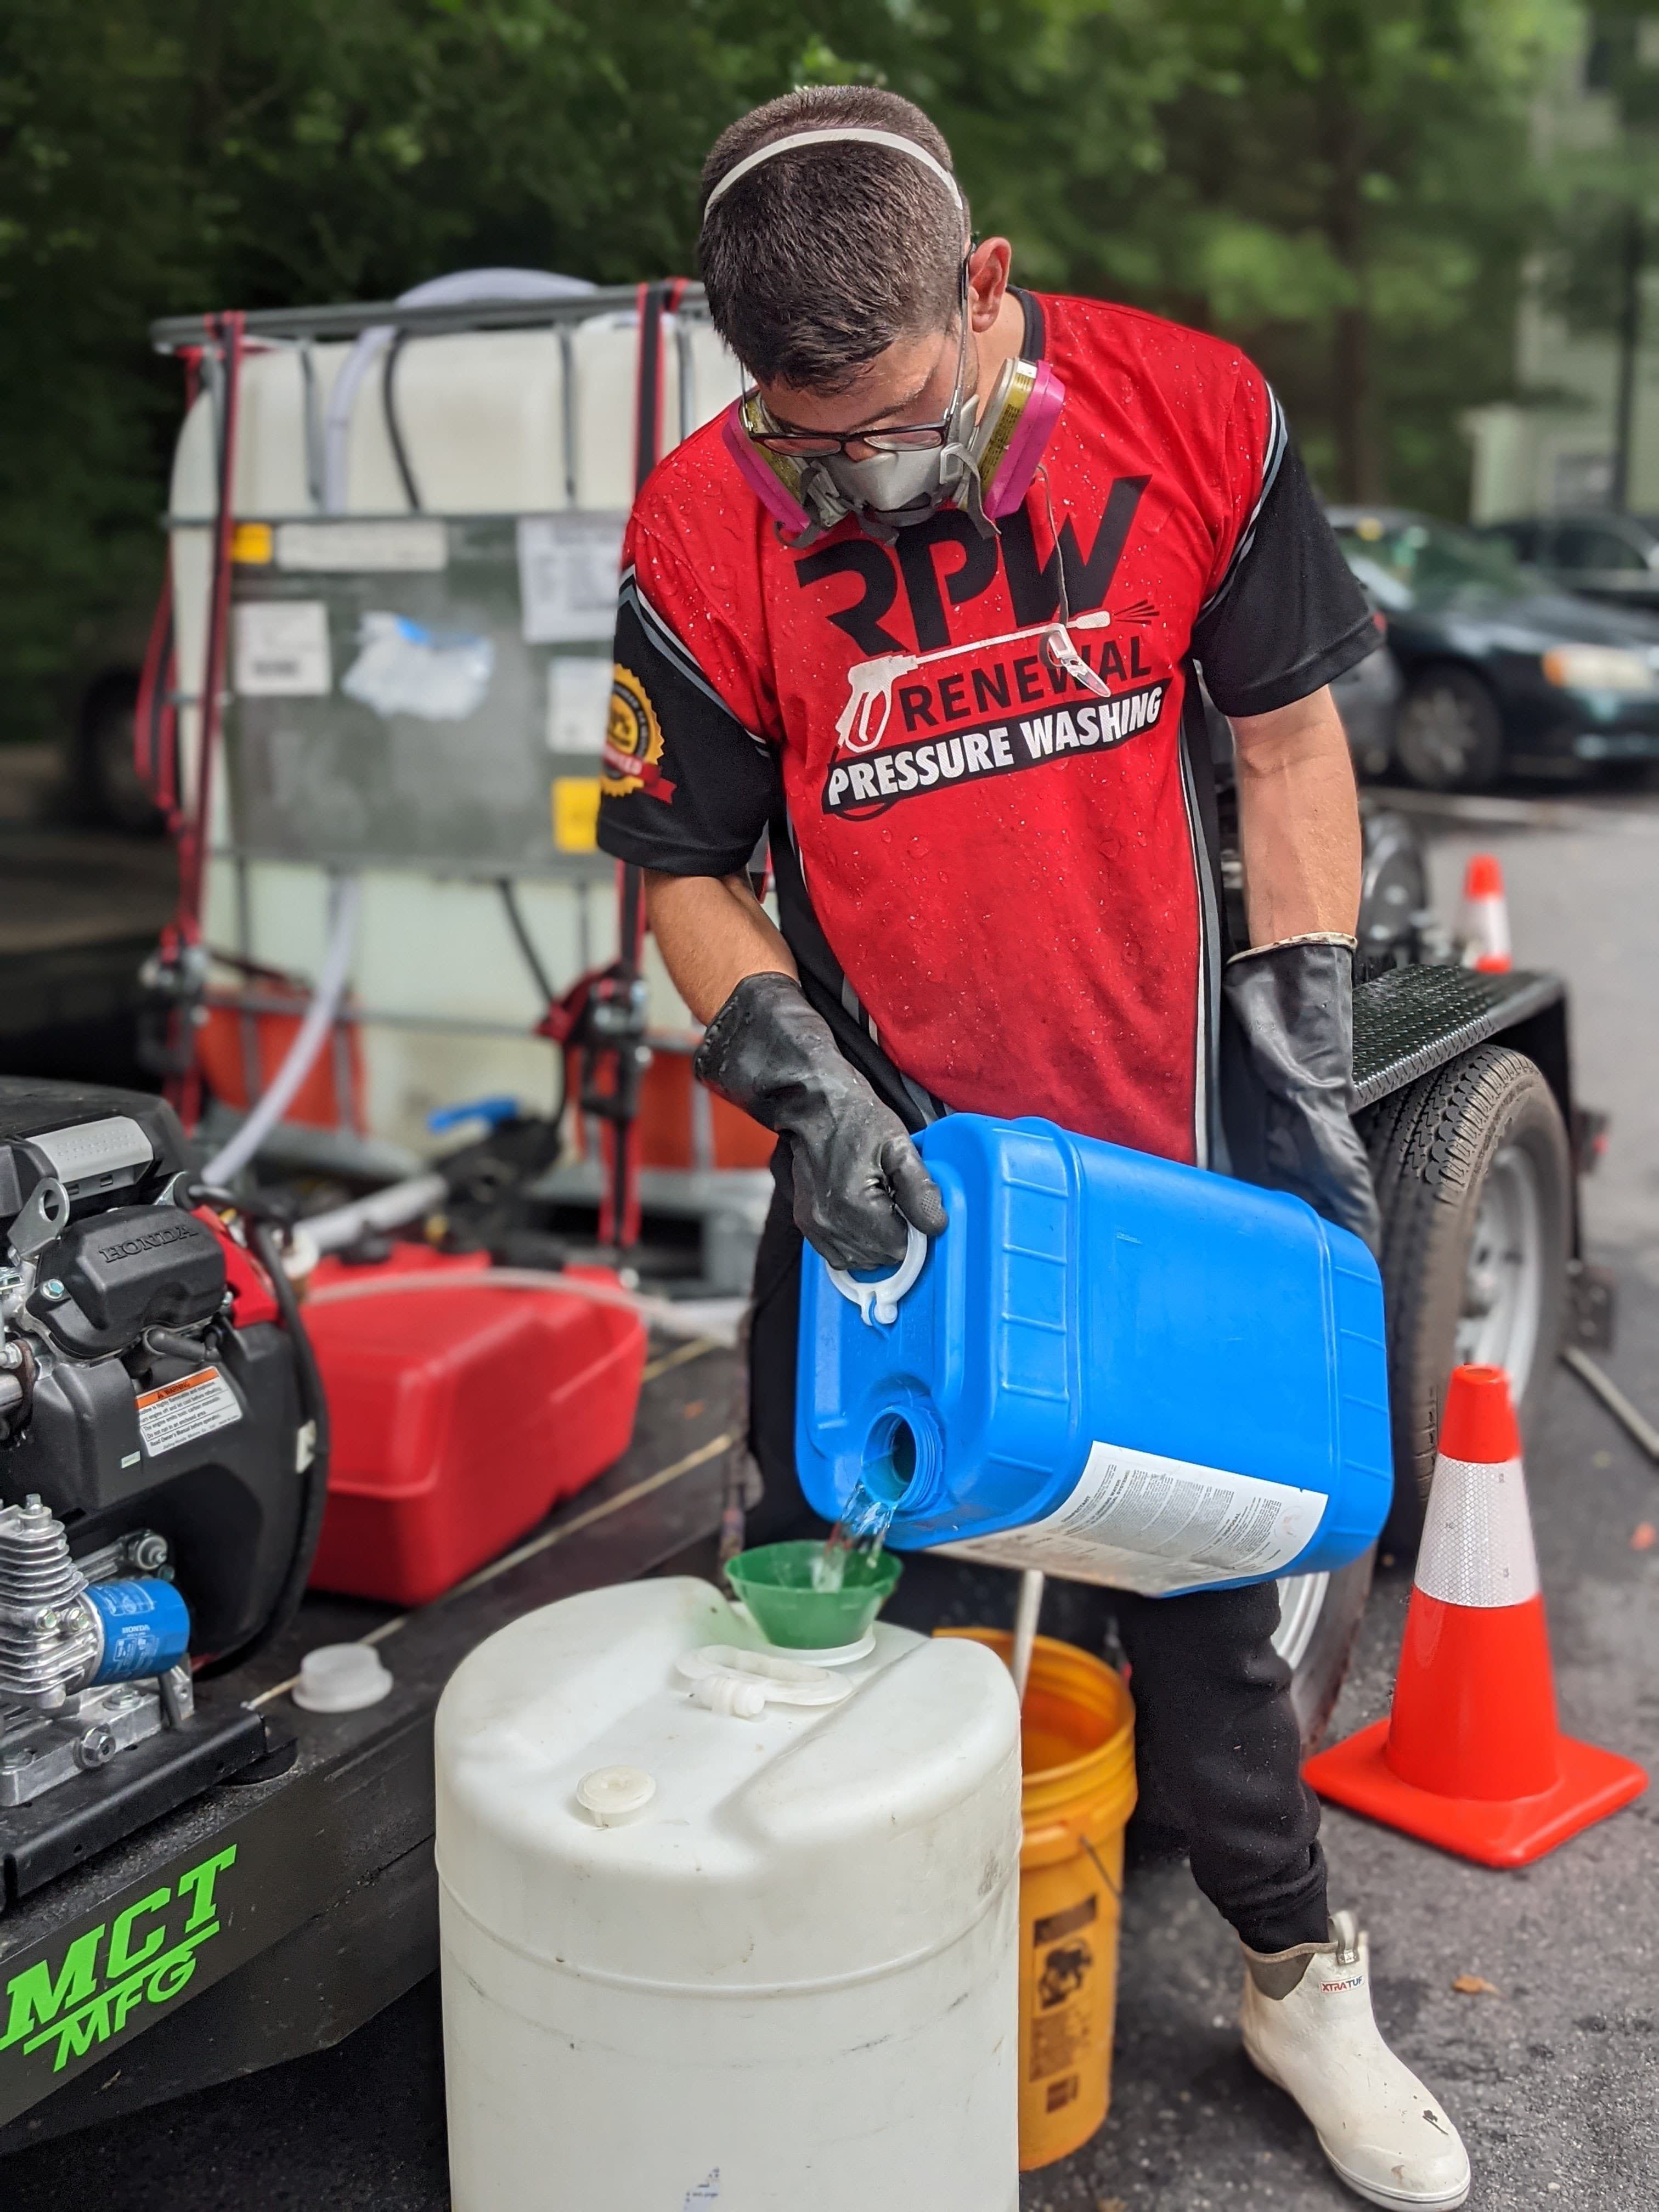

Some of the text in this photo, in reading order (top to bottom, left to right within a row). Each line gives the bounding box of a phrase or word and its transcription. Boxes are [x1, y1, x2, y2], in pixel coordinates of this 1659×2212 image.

[795, 475, 1152, 656] RPW
[900, 635, 1152, 732] RENEWAL
[828, 686, 1162, 806] PRESSURE WASHING
[99, 1224, 199, 1263] HONDA
[122, 1624, 150, 1634] HONDA
[0, 1844, 236, 2052] MCT
[1321, 1976, 1363, 1991] XTRATUF
[53, 1945, 196, 2072] MFG
